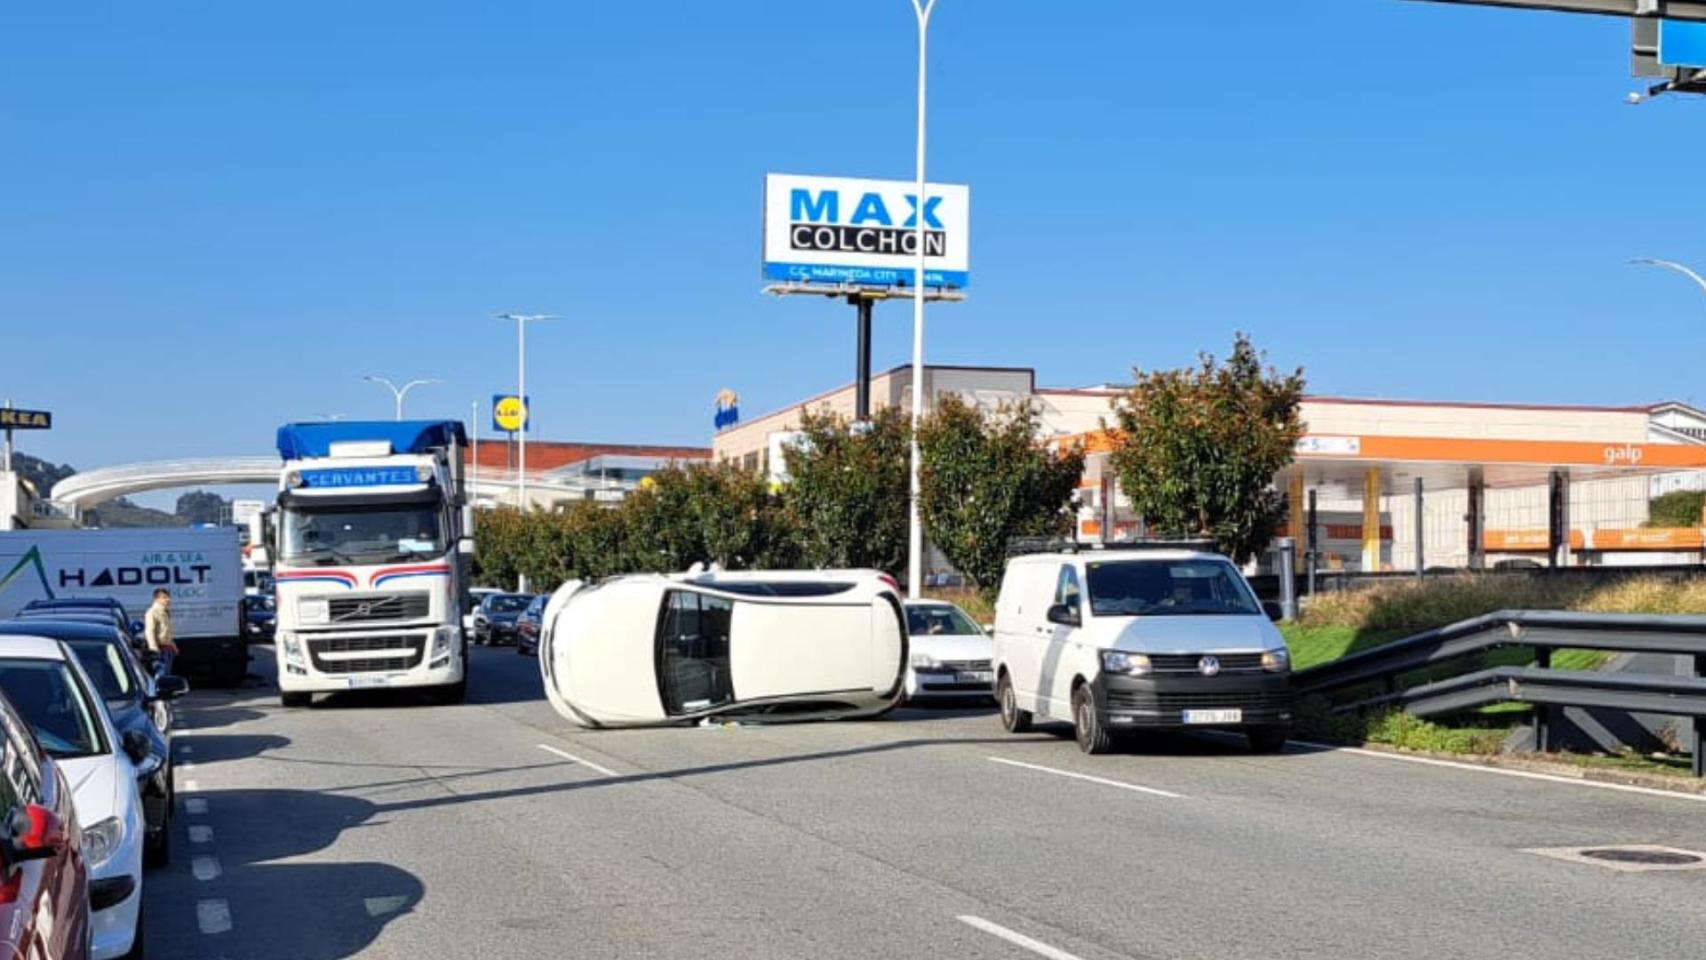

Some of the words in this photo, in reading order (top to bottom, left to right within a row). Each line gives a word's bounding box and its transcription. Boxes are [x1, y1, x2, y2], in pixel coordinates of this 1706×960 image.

[790, 188, 944, 229] MAX
[792, 226, 944, 255] COLCHON
[874, 270, 897, 281] CITY
[0, 410, 49, 426] KEA
[1603, 443, 1643, 464] galp
[308, 470, 412, 486] CERVANTES
[142, 553, 162, 564] AIR
[179, 552, 203, 562] SEA
[59, 565, 212, 587] HADOLT
